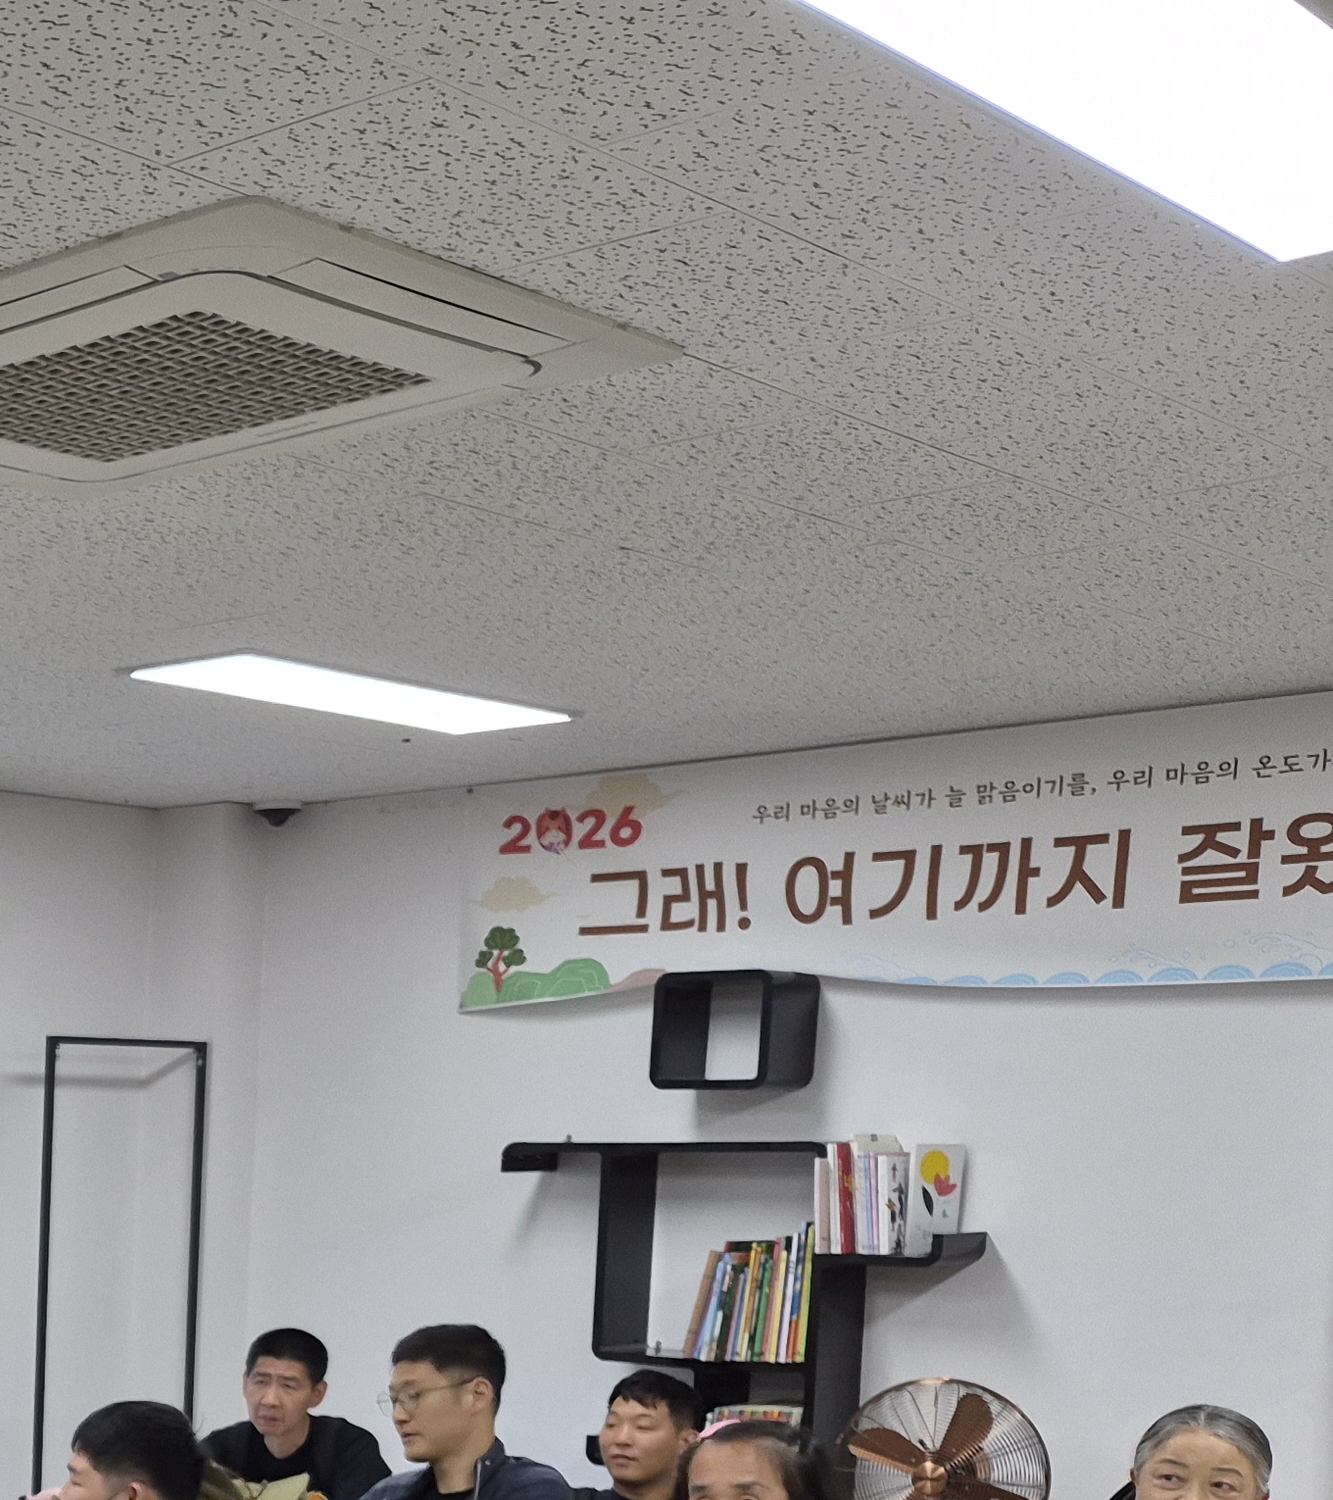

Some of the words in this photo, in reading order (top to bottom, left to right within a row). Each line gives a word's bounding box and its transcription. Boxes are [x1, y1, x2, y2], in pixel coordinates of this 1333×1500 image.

[752, 802, 791, 825] 우리
[799, 795, 860, 820] 마음의
[871, 788, 936, 815] 날씨가
[944, 785, 967, 808] 늘
[976, 772, 1097, 804] 맑음이기를,
[1107, 765, 1153, 792] 우리
[1165, 757, 1239, 786] 마음의
[1251, 748, 1333, 778] 온도가
[499, 805, 643, 855] 2026
[578, 861, 752, 936] 그래!
[785, 827, 1132, 926] 여기까지
